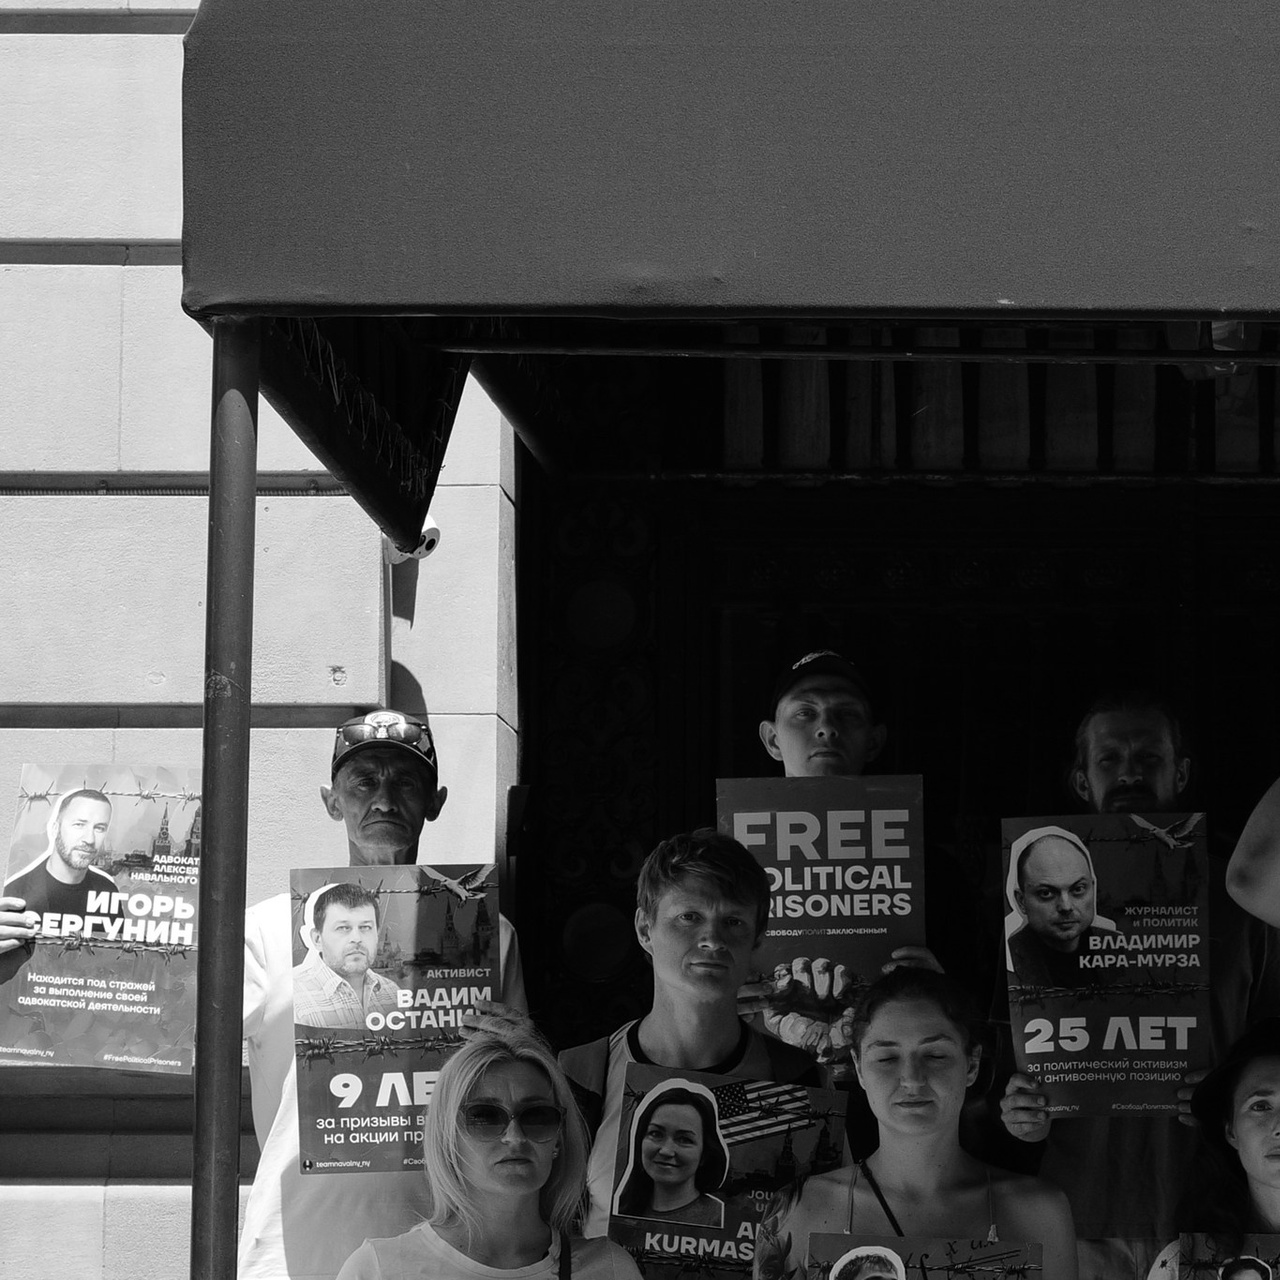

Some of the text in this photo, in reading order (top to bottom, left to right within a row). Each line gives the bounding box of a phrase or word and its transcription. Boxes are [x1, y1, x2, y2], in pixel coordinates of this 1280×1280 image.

[734, 809, 910, 861] FREE
[153, 854, 199, 866] АДВОКАТ
[153, 864, 199, 875] АЛЕКСЕЯ
[131, 872, 198, 884] НАВАЛЬНОГО
[765, 865, 912, 891] OLITICAL
[86, 890, 194, 919] ИГОРЬ
[1125, 906, 1198, 916] ЖУРНАЛИСТ
[1143, 918, 1199, 927] ПОЛИТИК
[1089, 934, 1200, 951] ВЛАДИМИР
[1079, 954, 1200, 969] КАРА-МУРЗА
[426, 968, 491, 978] АКТИВИСТ
[28, 972, 155, 992] Находится под стражей
[33, 986, 147, 1002] за выполнение своей
[397, 987, 492, 1009] ВАДИМ
[18, 997, 160, 1015] адвокатской деятельности
[1024, 1016, 1197, 1054] 25 ЛЕТ
[1028, 1058, 1188, 1073] за политический активизм
[1045, 1072, 1126, 1084] антивоенную
[1130, 1071, 1181, 1082] позицию
[329, 1072, 441, 1108] 9 ЛЕ
[316, 1117, 336, 1129] за
[340, 1116, 411, 1128] призывы
[324, 1132, 344, 1144] на
[349, 1131, 398, 1144] акции
[644, 1232, 754, 1260] KURMAS
